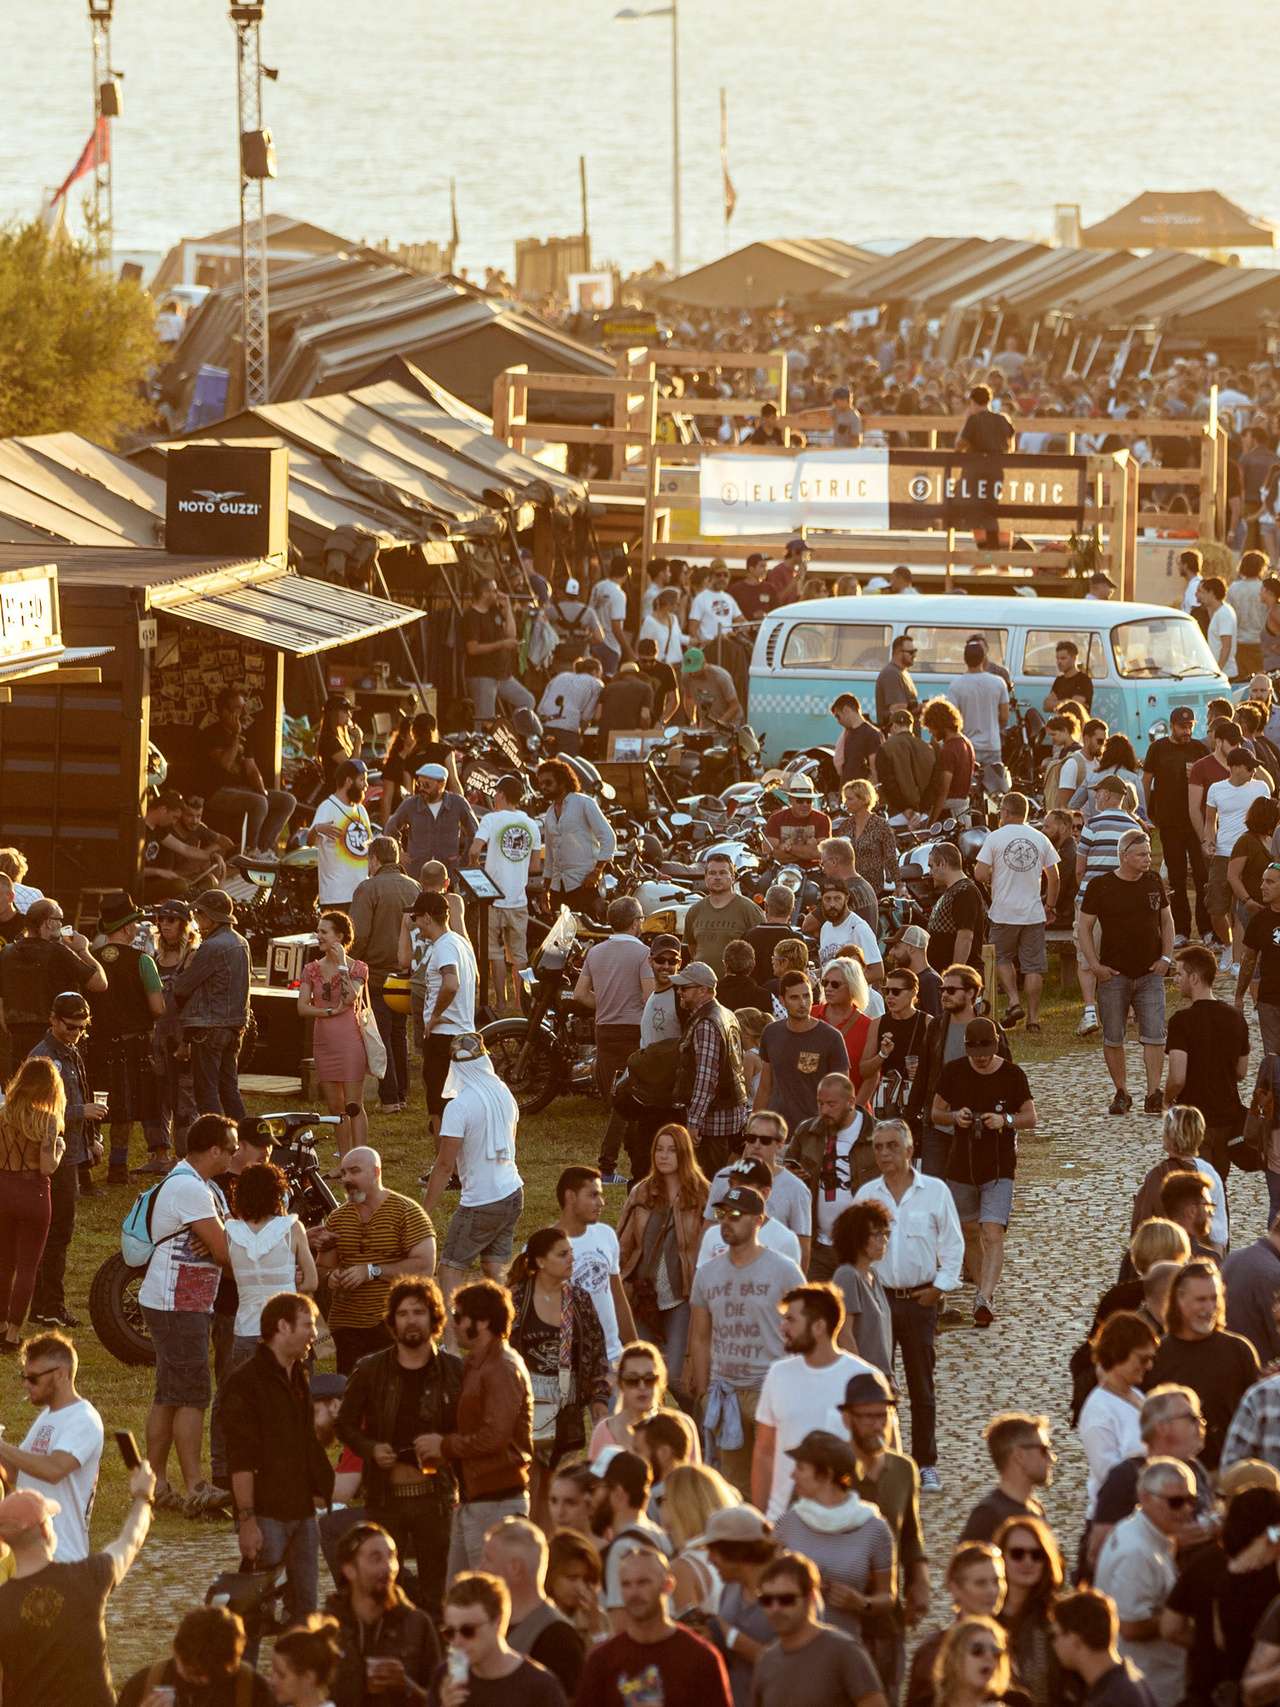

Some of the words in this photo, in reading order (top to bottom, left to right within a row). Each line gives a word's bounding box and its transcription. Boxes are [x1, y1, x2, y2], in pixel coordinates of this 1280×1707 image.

[753, 479, 867, 502] ELECTRIC
[945, 477, 1063, 504] ELECTRIC
[178, 500, 215, 513] MOTO
[219, 502, 258, 515] GUZZI
[142, 629, 155, 641] 69
[696, 920, 736, 929] ELECTRIC
[724, 1301, 746, 1318] DIE
